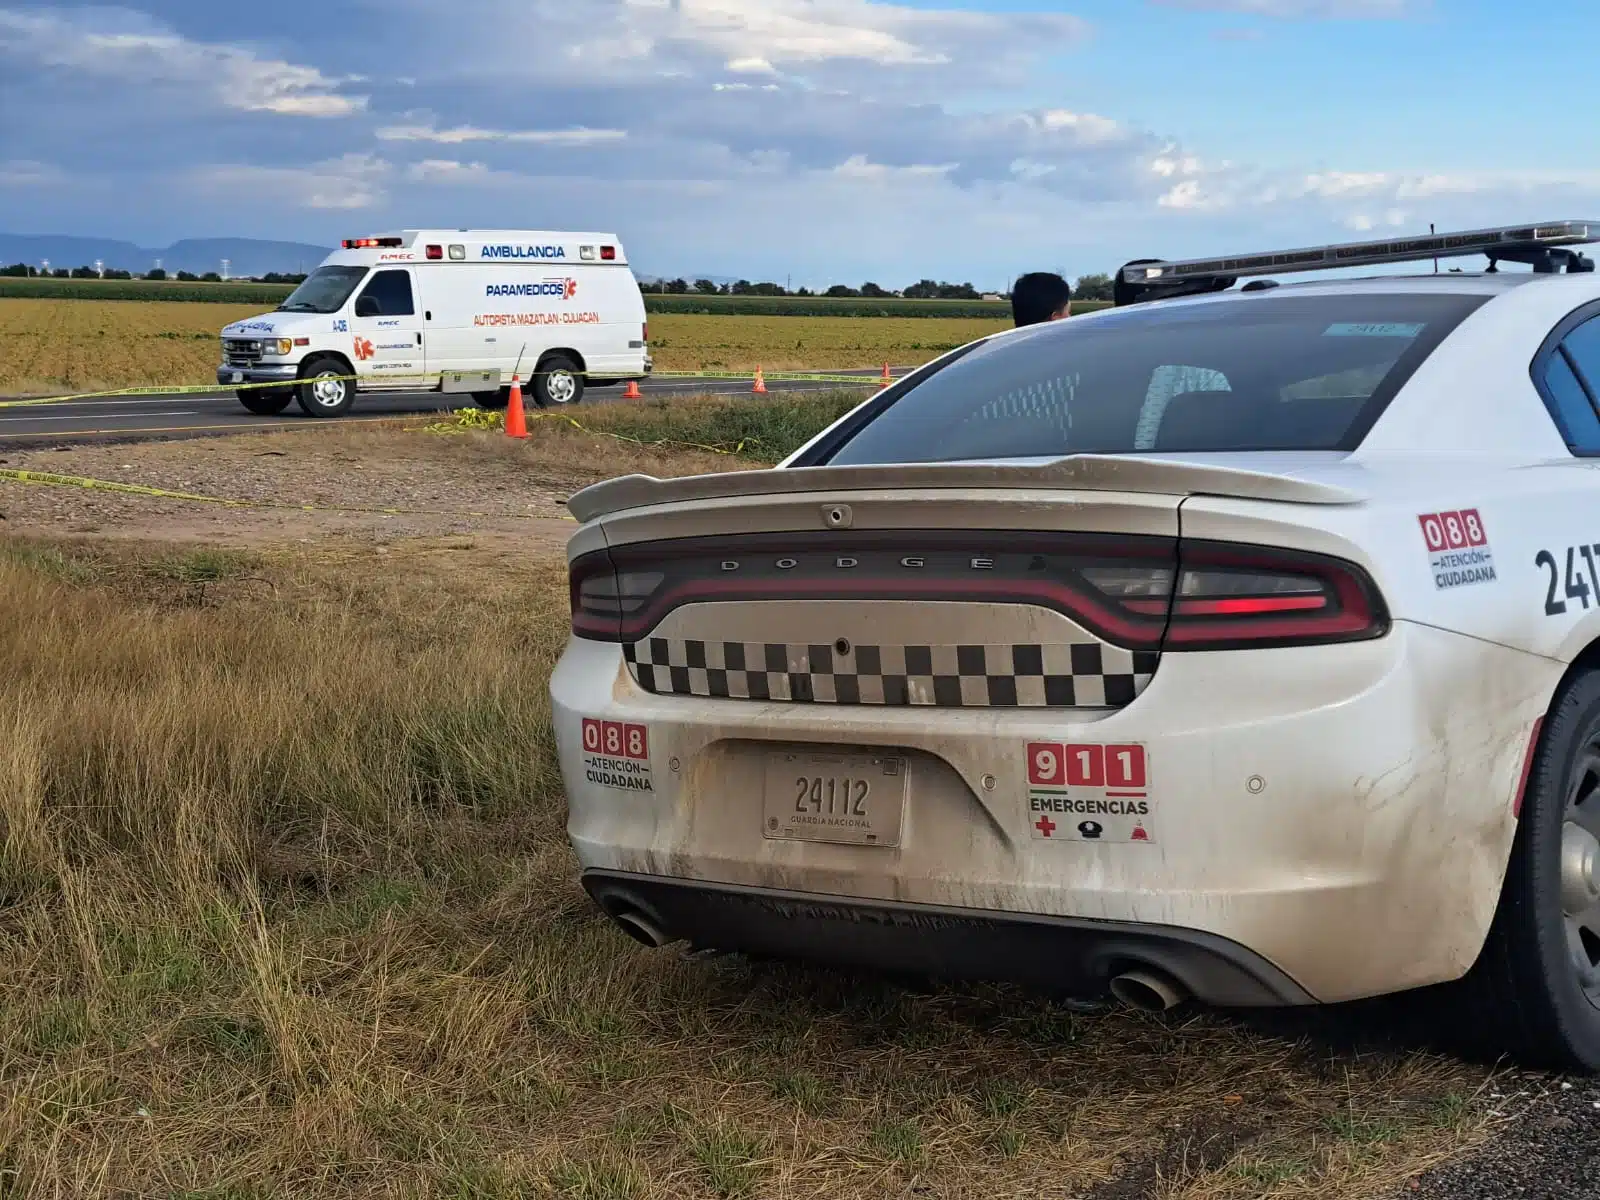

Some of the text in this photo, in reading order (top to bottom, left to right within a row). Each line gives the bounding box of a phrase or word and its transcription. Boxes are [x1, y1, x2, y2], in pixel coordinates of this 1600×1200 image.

[481, 245, 566, 258] AMBULANCIA
[486, 283, 564, 297] PARAMEDICOS
[474, 315, 516, 326] AUTOPISTA
[516, 313, 559, 325] MAZATLAN
[562, 311, 600, 324] CULIACAN
[1425, 514, 1483, 548] 088
[721, 556, 994, 571] DODGE
[1440, 549, 1485, 569] ATENCIÓN
[1435, 566, 1497, 588] CIUDADANA
[1535, 543, 1600, 617] 241
[585, 723, 643, 755] 088
[591, 756, 641, 774] ATENCIÓN
[1036, 750, 1132, 780] 911
[586, 769, 653, 792] CIUDADANA
[795, 777, 870, 816] 24112
[1030, 798, 1149, 815] EMERGENCIAS
[790, 815, 872, 829] GUARDIA NACIONAL
